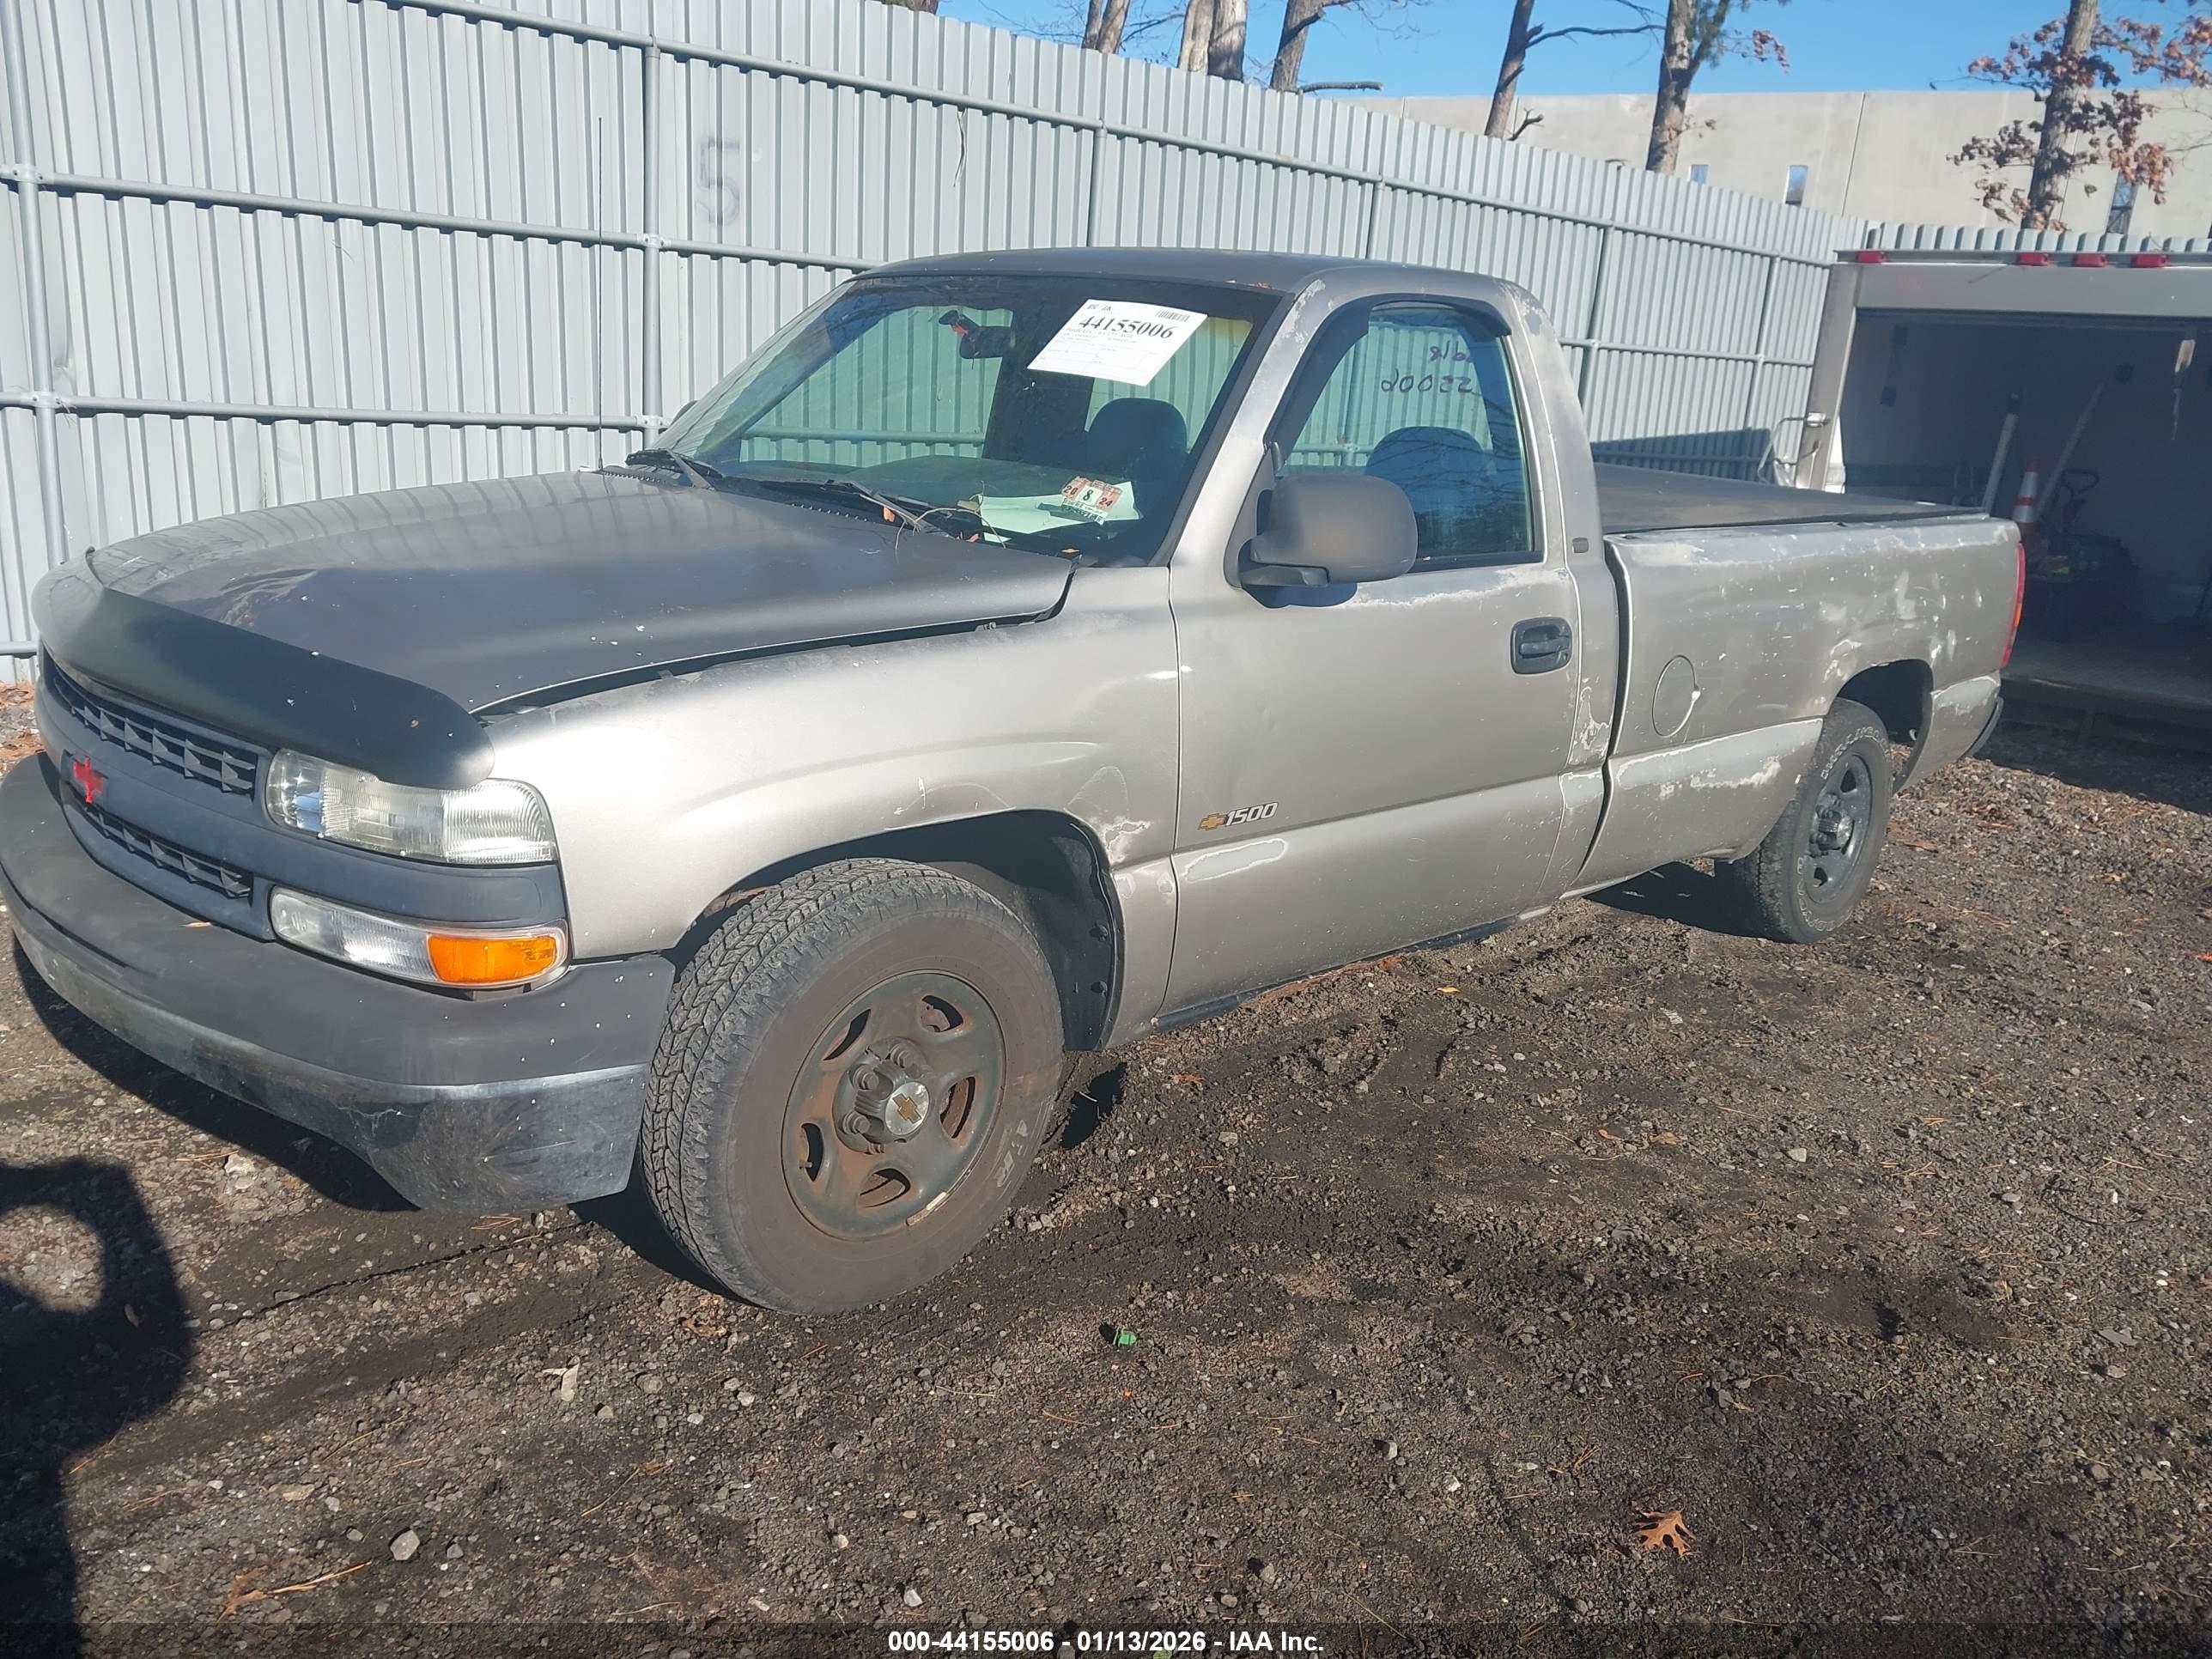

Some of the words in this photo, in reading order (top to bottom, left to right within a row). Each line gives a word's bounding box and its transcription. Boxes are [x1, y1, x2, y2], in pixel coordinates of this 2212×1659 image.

[697, 137, 740, 227] 5
[1079, 315, 1179, 340] 44155006
[1064, 485, 1079, 495] 20
[1083, 489, 1093, 501] 8
[1098, 497, 1113, 507] 24
[1225, 801, 1279, 826] 1500
